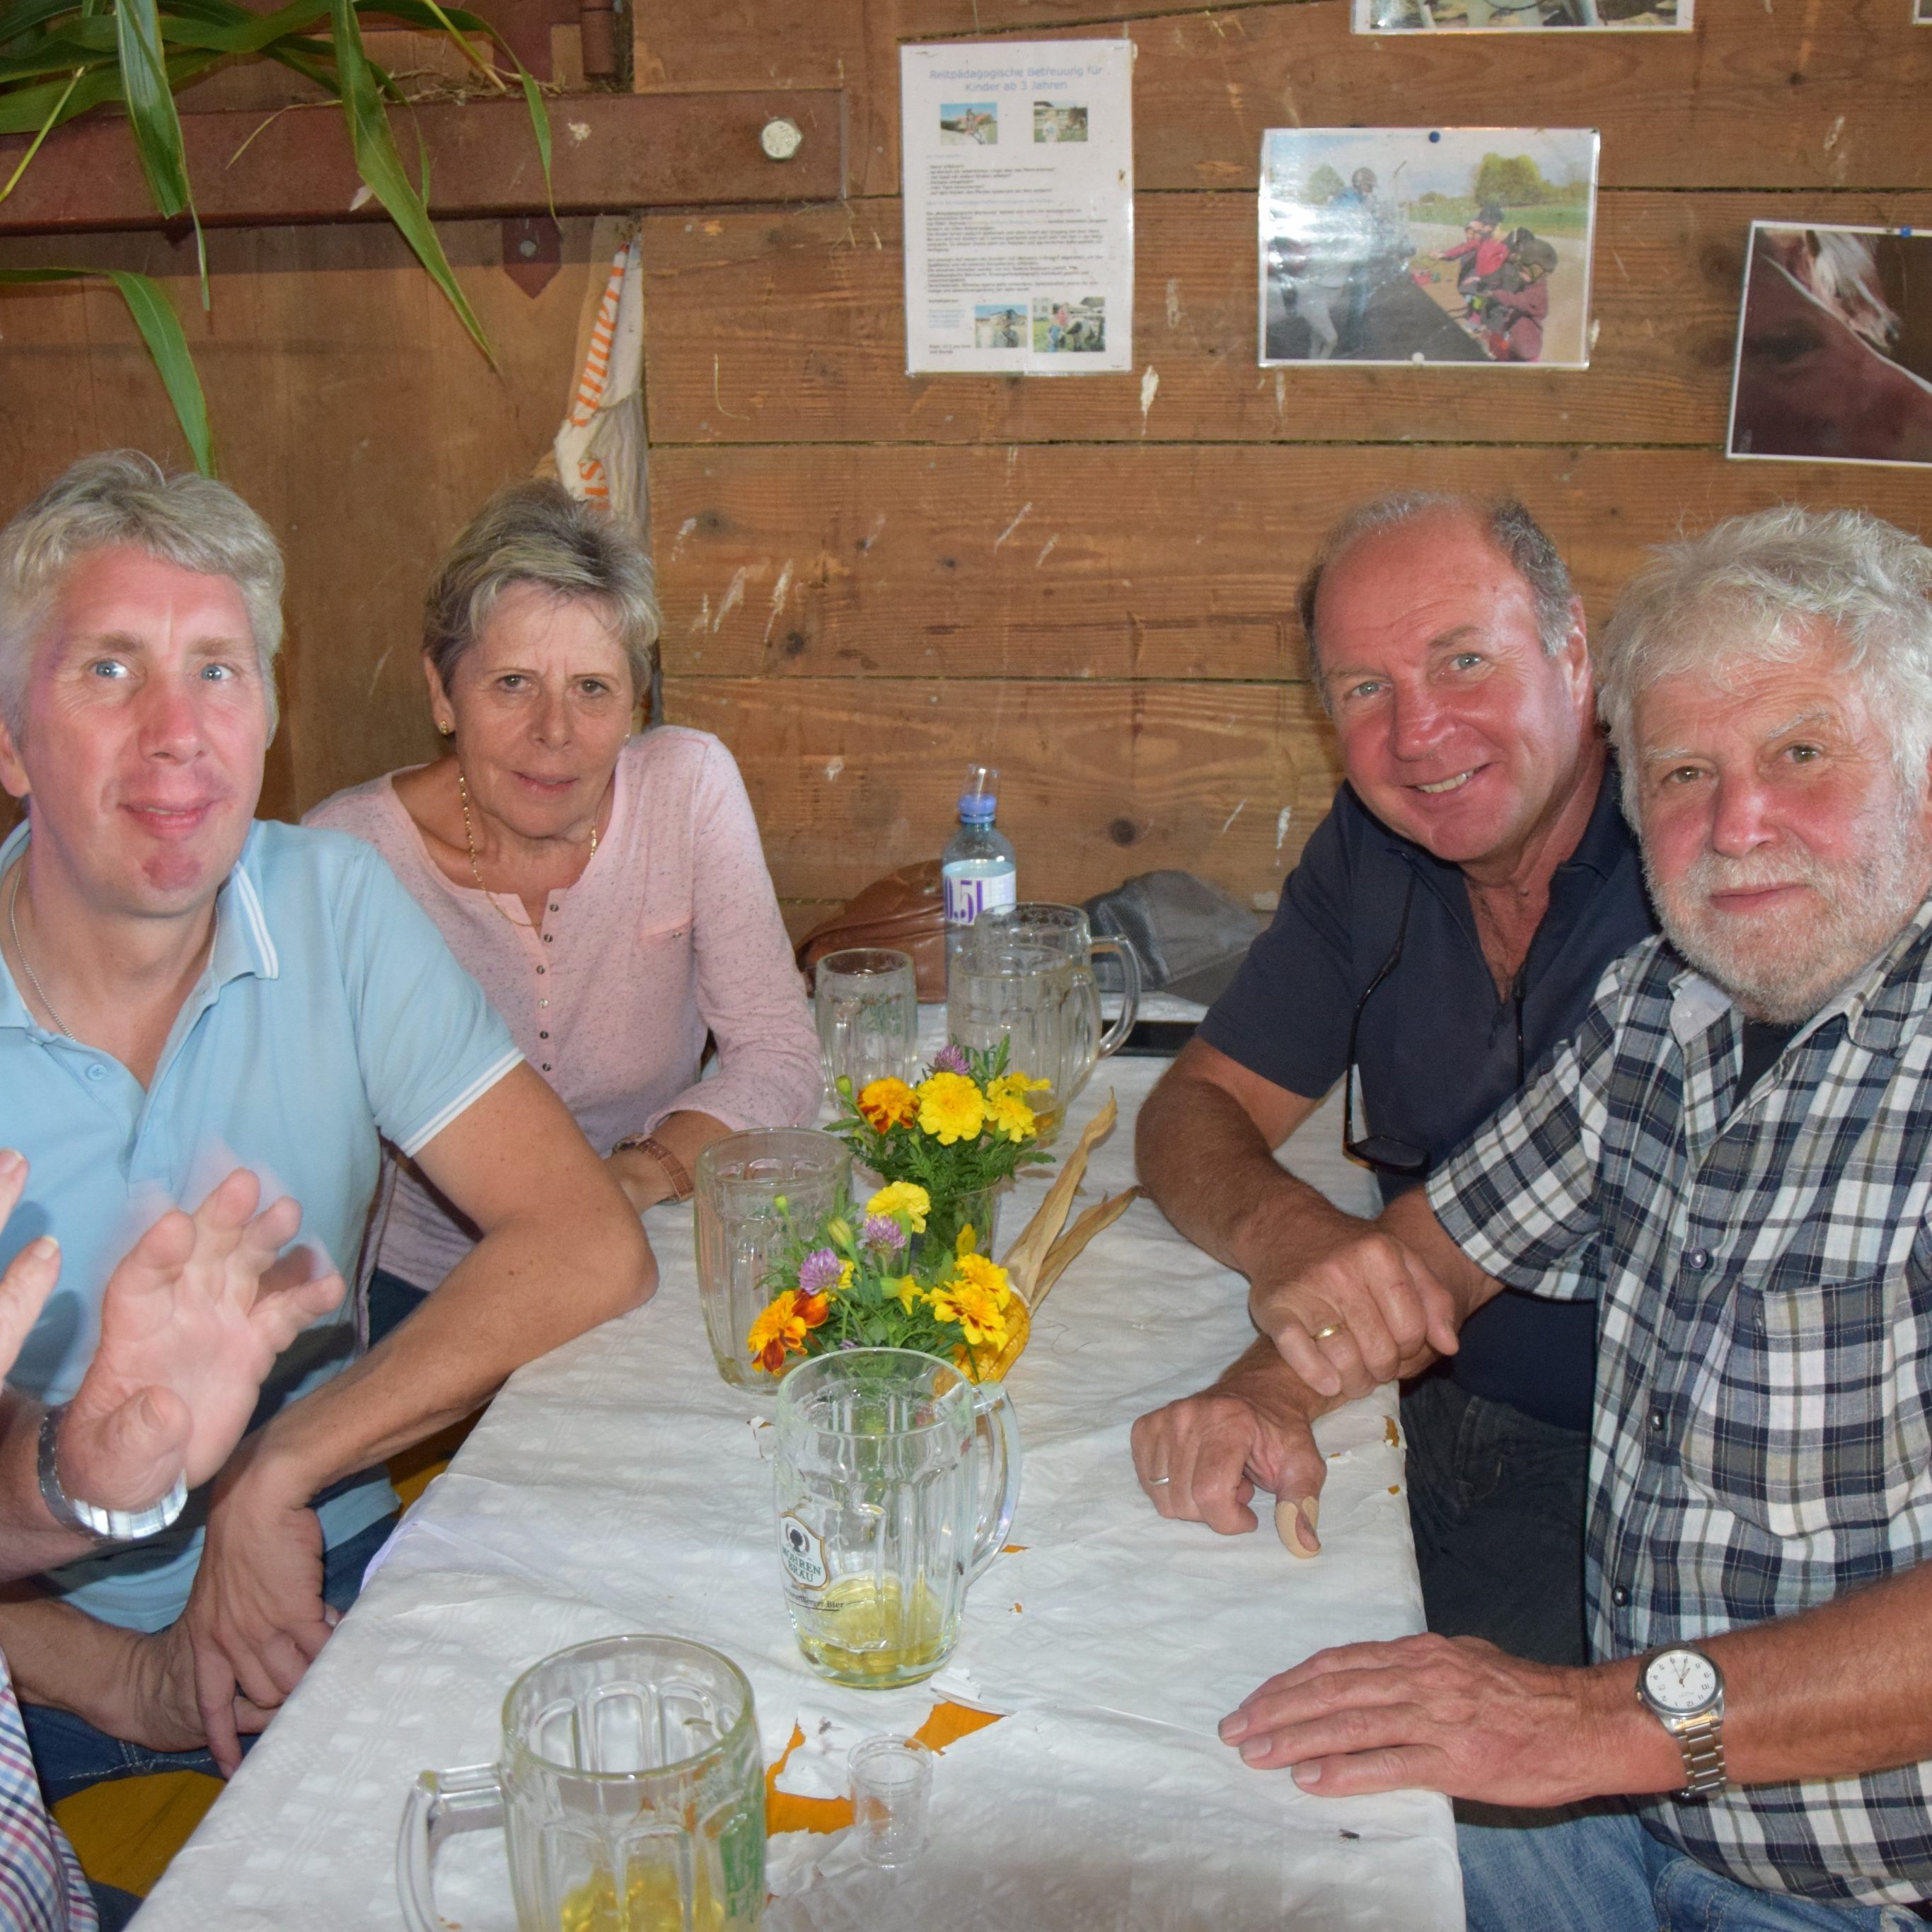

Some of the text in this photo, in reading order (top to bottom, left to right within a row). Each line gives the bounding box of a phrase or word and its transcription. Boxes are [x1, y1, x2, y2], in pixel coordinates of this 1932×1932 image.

[1027, 66, 1084, 79] Betreuung
[1087, 65, 1103, 76] für
[965, 81, 1067, 92] Kinder ab 3 Jahren
